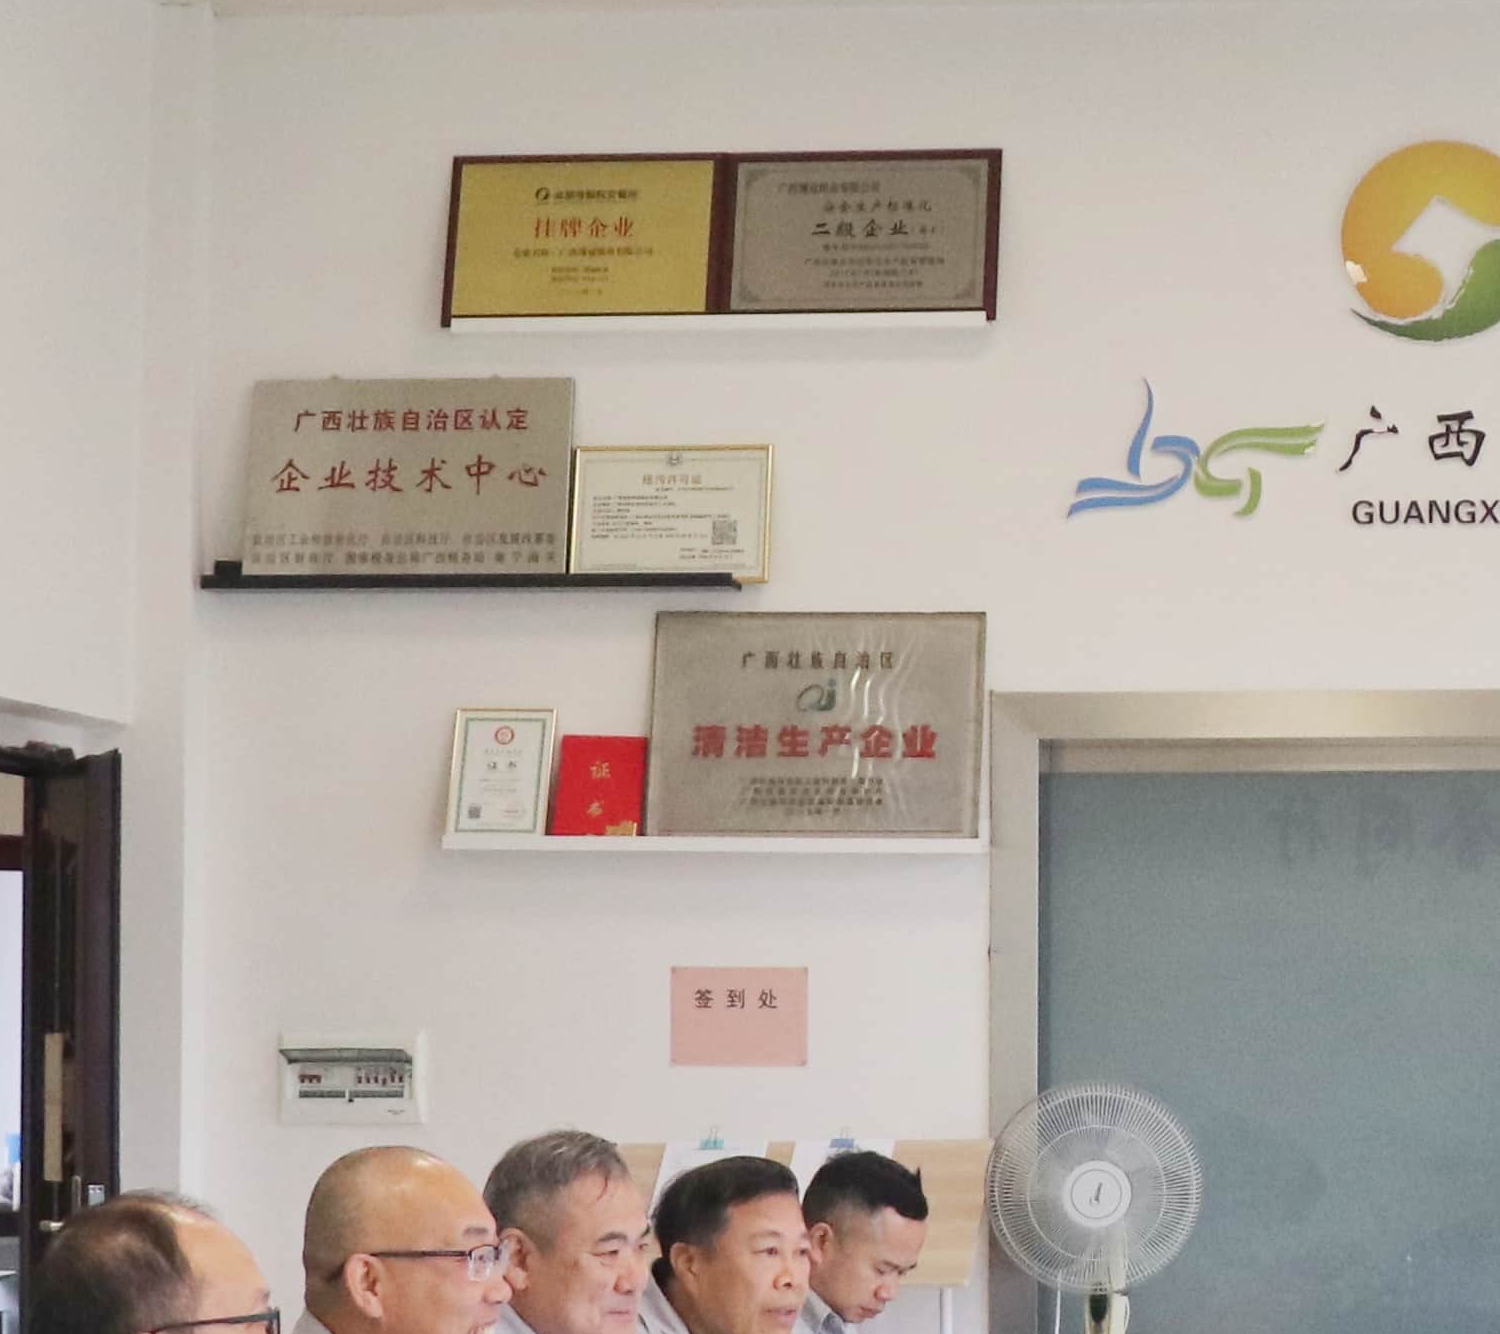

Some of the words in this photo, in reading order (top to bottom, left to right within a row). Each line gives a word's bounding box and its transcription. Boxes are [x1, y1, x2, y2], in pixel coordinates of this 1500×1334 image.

[533, 215, 636, 241] 挂牌企业
[293, 407, 530, 434] 广西壮族自治区认定
[272, 452, 549, 497] 企业技术中心
[692, 723, 938, 760] 清洁生产企业
[694, 988, 780, 1010] 签到处
